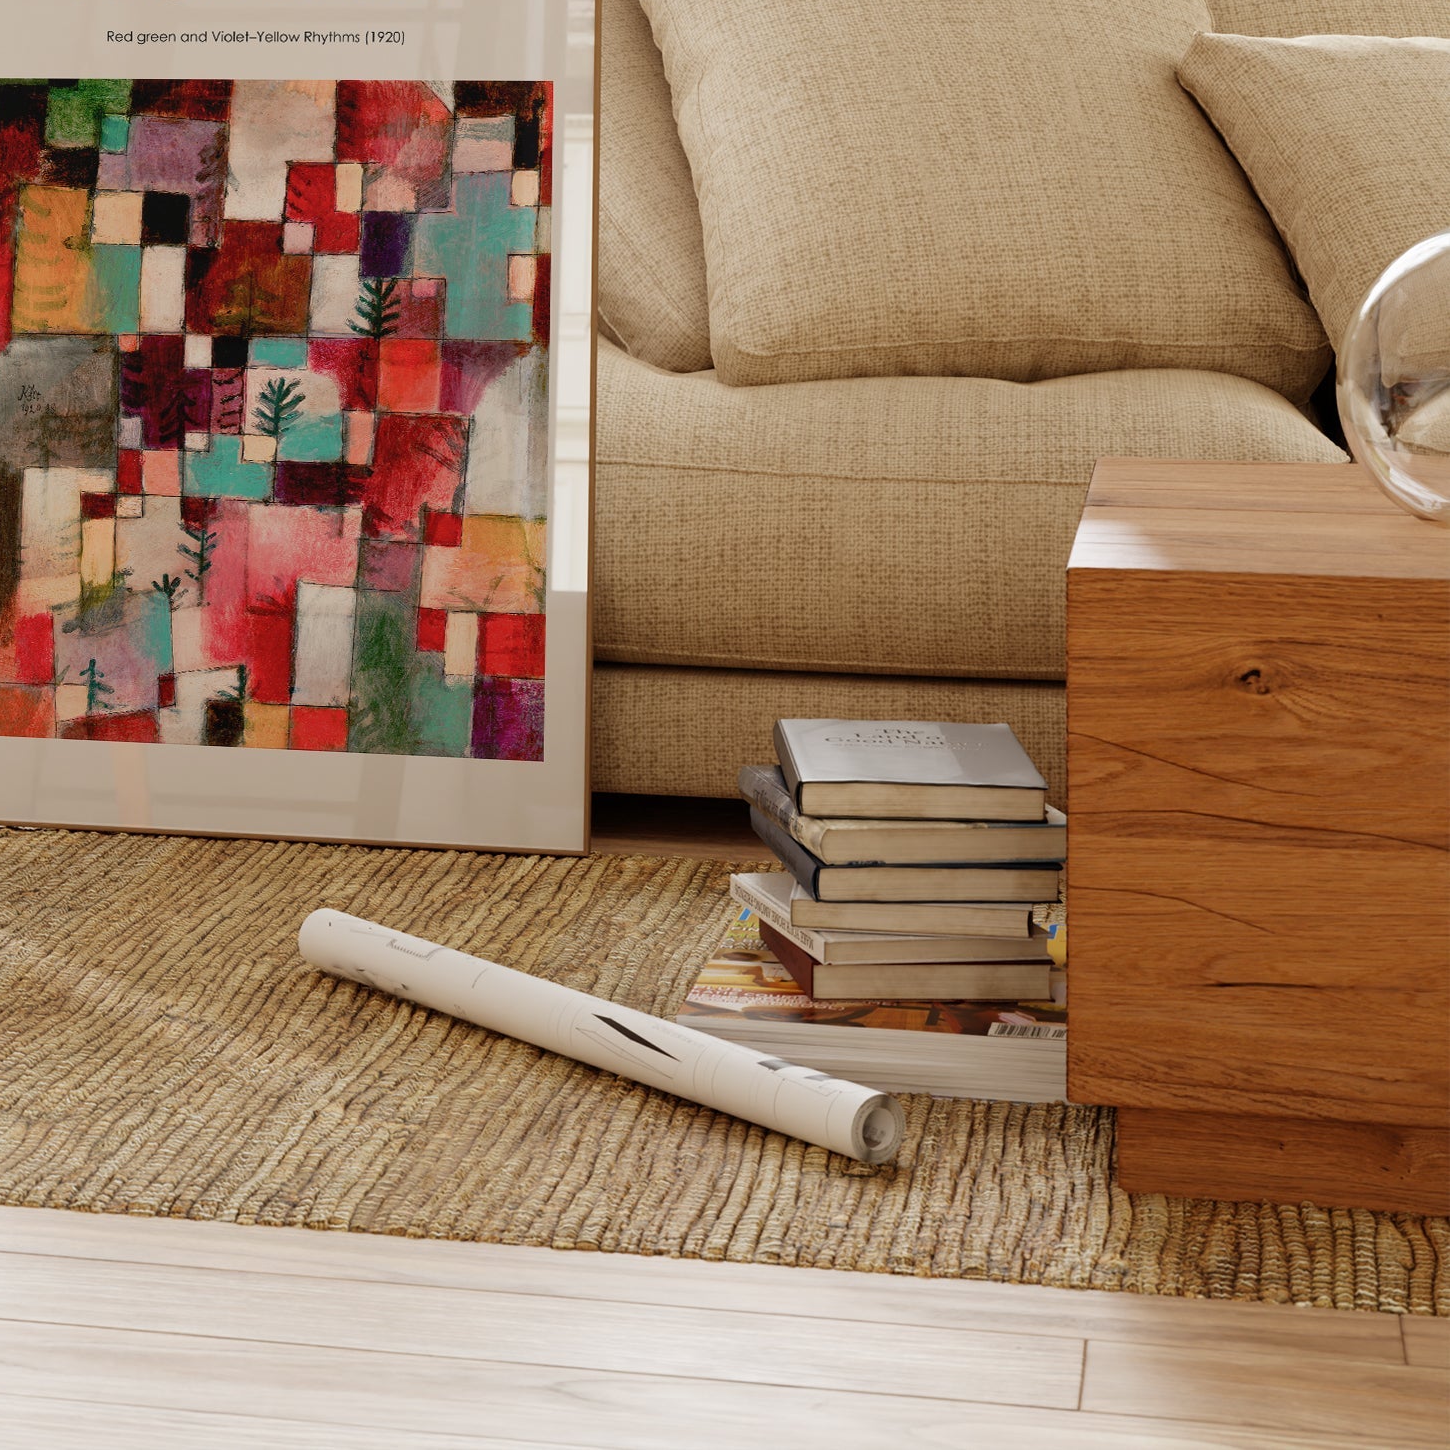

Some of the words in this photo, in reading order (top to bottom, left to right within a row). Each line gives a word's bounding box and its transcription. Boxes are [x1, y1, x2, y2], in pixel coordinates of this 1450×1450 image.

[106, 30, 133, 43] Red
[136, 32, 177, 45] green
[180, 30, 208, 43] and
[303, 30, 361, 46] Rhythms
[365, 30, 406, 46] (1920)
